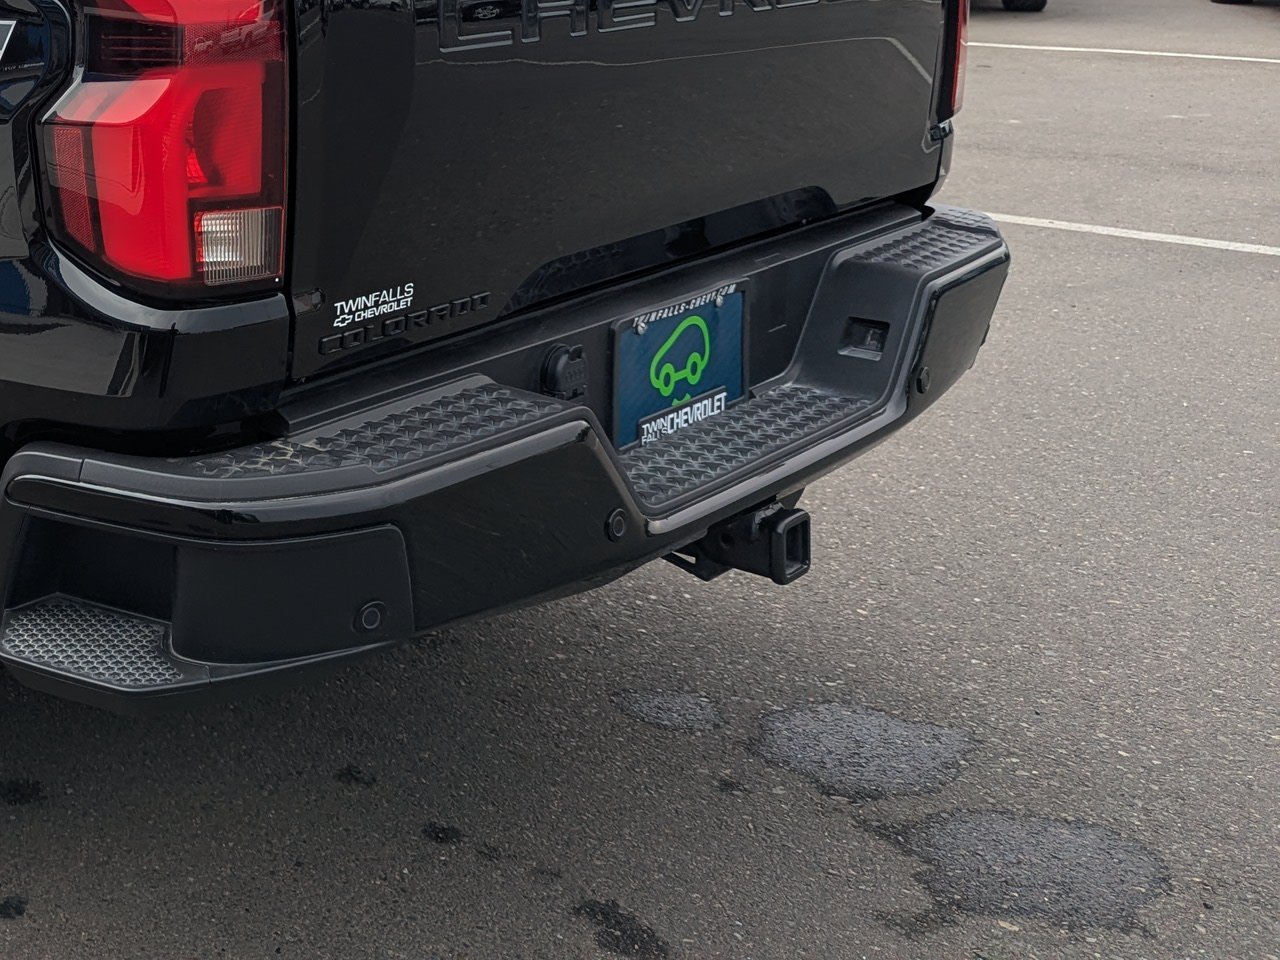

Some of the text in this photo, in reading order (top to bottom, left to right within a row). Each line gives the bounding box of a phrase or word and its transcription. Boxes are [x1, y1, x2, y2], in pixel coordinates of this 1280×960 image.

[334, 282, 414, 316] TWINFALLS
[354, 297, 413, 322] CHEVROLET
[319, 291, 491, 355] COLORADO
[641, 415, 668, 438] TWIN
[667, 391, 727, 435] CHEVROLET
